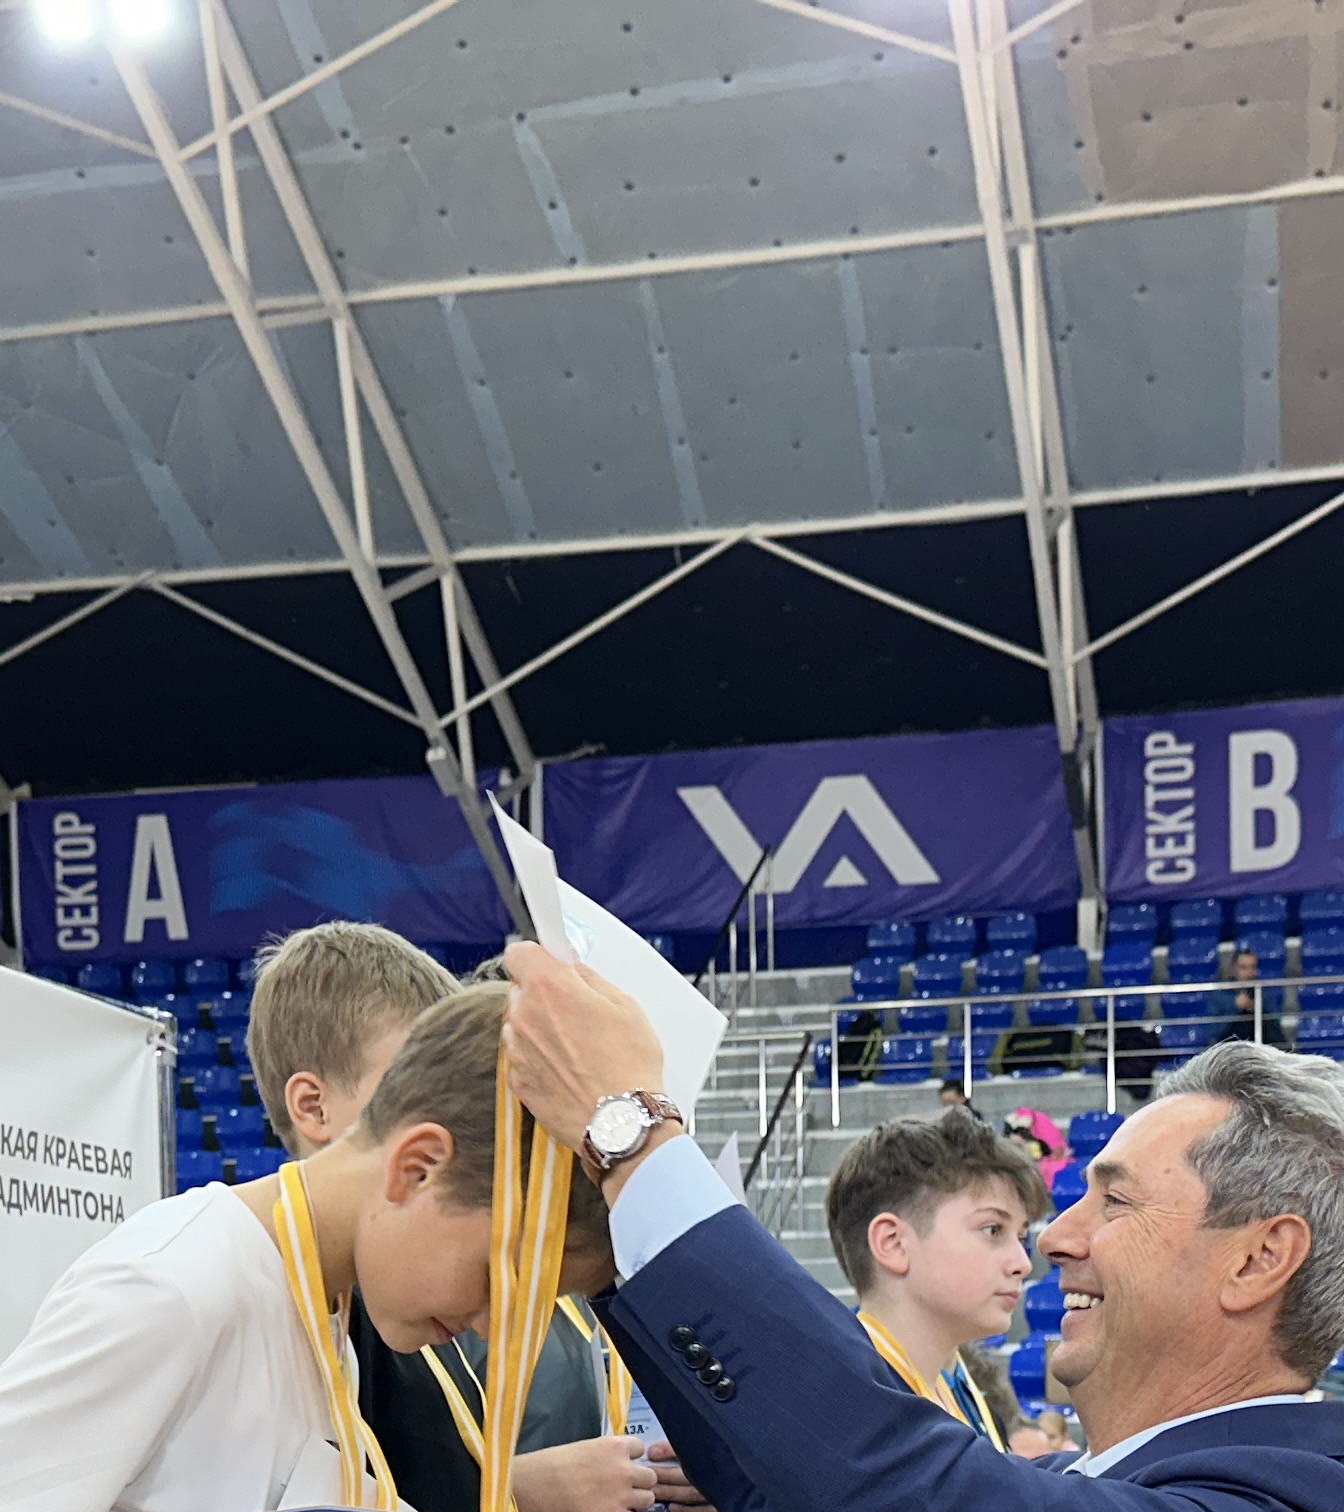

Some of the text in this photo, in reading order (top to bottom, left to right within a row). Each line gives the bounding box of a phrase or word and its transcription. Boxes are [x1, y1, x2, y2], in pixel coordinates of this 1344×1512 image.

[1144, 729, 1302, 885] СЕКТОР B
[53, 811, 100, 951] СЕКТОР
[43, 1134, 133, 1180] КРАЕВАЯ
